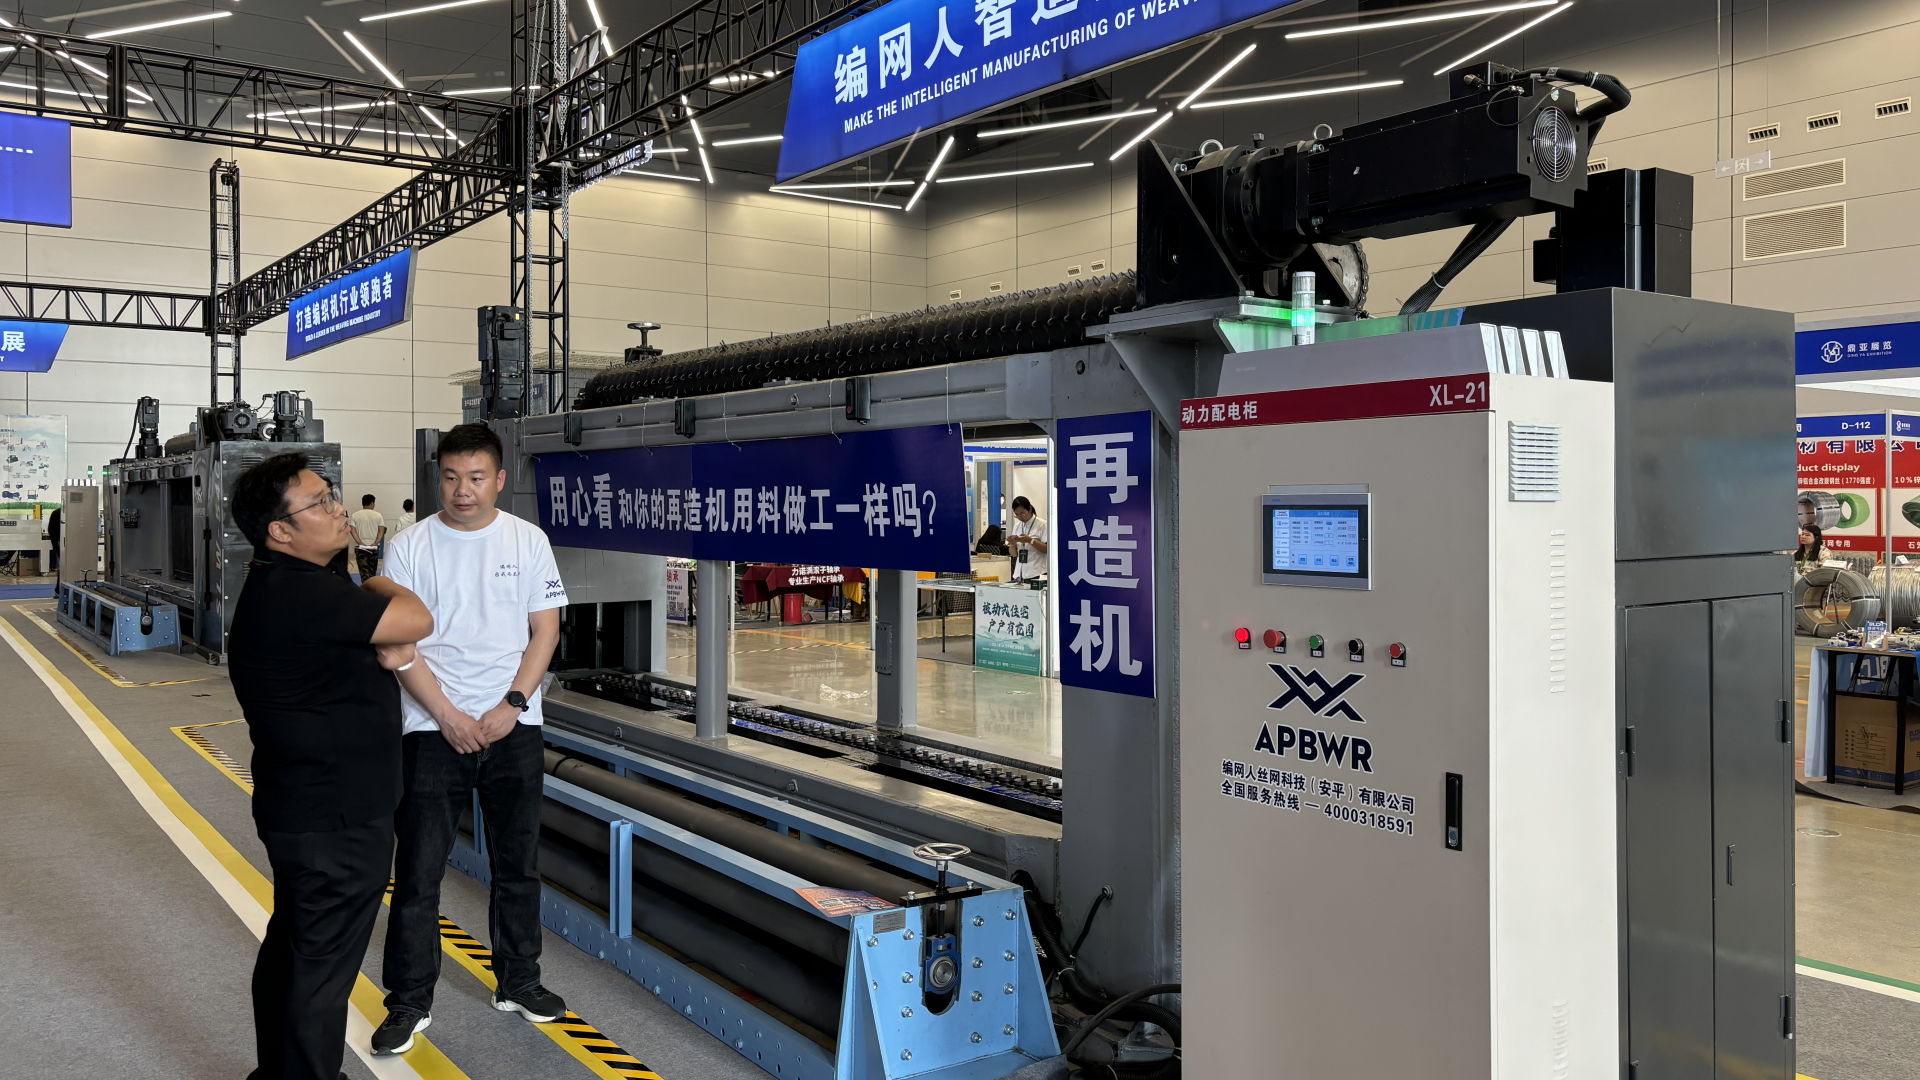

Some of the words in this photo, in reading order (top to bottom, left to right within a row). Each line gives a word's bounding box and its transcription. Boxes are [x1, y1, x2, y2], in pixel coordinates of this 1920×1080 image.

[844, 109, 874, 134] MAKE
[876, 99, 898, 120] THE
[901, 67, 978, 111] INTELLIGENT
[982, 18, 1108, 80] MANUFACTURING
[1114, 7, 1136, 30] OF
[1142, 0, 1198, 20] WEAV
[296, 271, 393, 333] 打造编织机行业领跑者
[316, 328, 326, 339] LEADER
[335, 319, 350, 331] WEAVING
[349, 315, 364, 327] MACHINE
[364, 309, 381, 322] INDUSTRY
[1, 331, 26, 353] 展
[1847, 341, 1892, 353] 鼎亚展览
[1429, 381, 1486, 407] XL-21
[1181, 400, 1258, 425] 动力配电柜
[1841, 421, 1871, 430] D-112
[1821, 463, 1860, 474] display
[1066, 432, 1143, 677] 再造机
[788, 574, 844, 586] 专业生产NCF轴承
[545, 590, 566, 599] APBWR
[988, 618, 1035, 639] 户户有花园
[1254, 721, 1374, 774] APBWR
[1221, 759, 1415, 816] 编网人丝网科技（安平）有限公司
[1220, 779, 1301, 812] 全国服务热线
[1323, 803, 1414, 837] 4000318591
